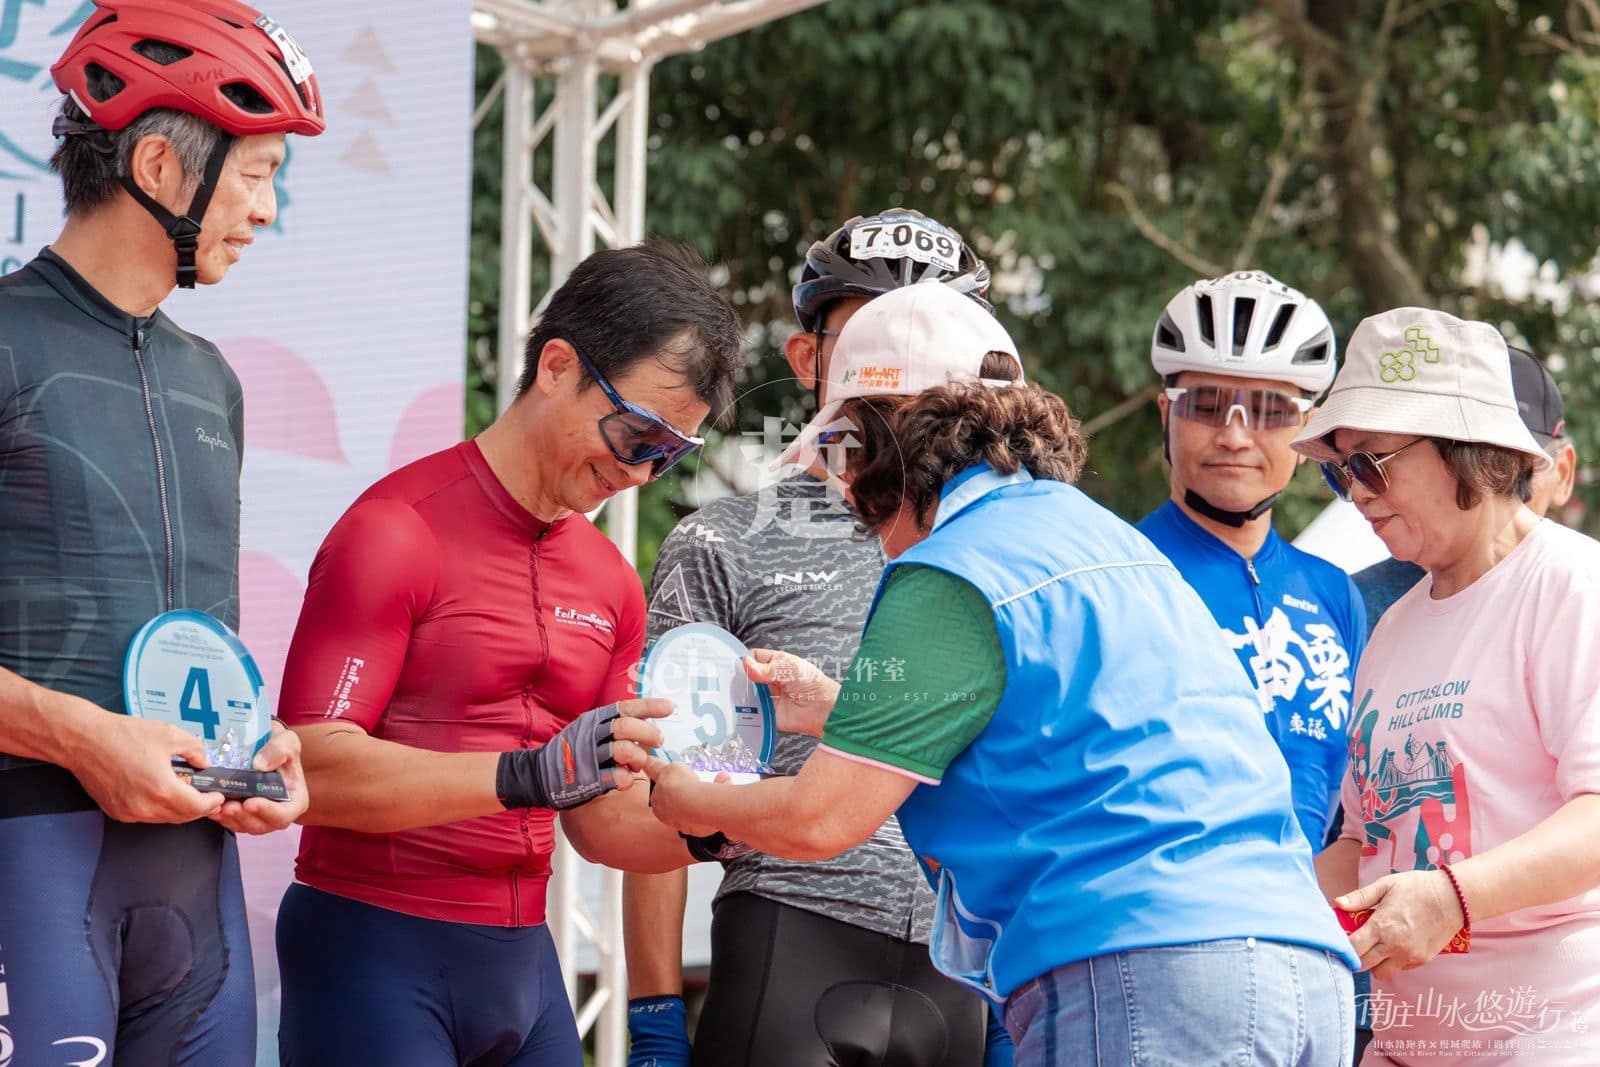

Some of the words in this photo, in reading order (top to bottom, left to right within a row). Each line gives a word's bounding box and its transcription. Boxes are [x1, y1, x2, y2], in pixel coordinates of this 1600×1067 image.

[195, 427, 231, 452] Rapha
[774, 570, 839, 585] NW
[179, 666, 221, 741] 4
[1395, 680, 1471, 709] CITTASLOW
[690, 675, 727, 746] 5
[1388, 711, 1414, 731] HILL
[1416, 702, 1464, 722] CLIMB
